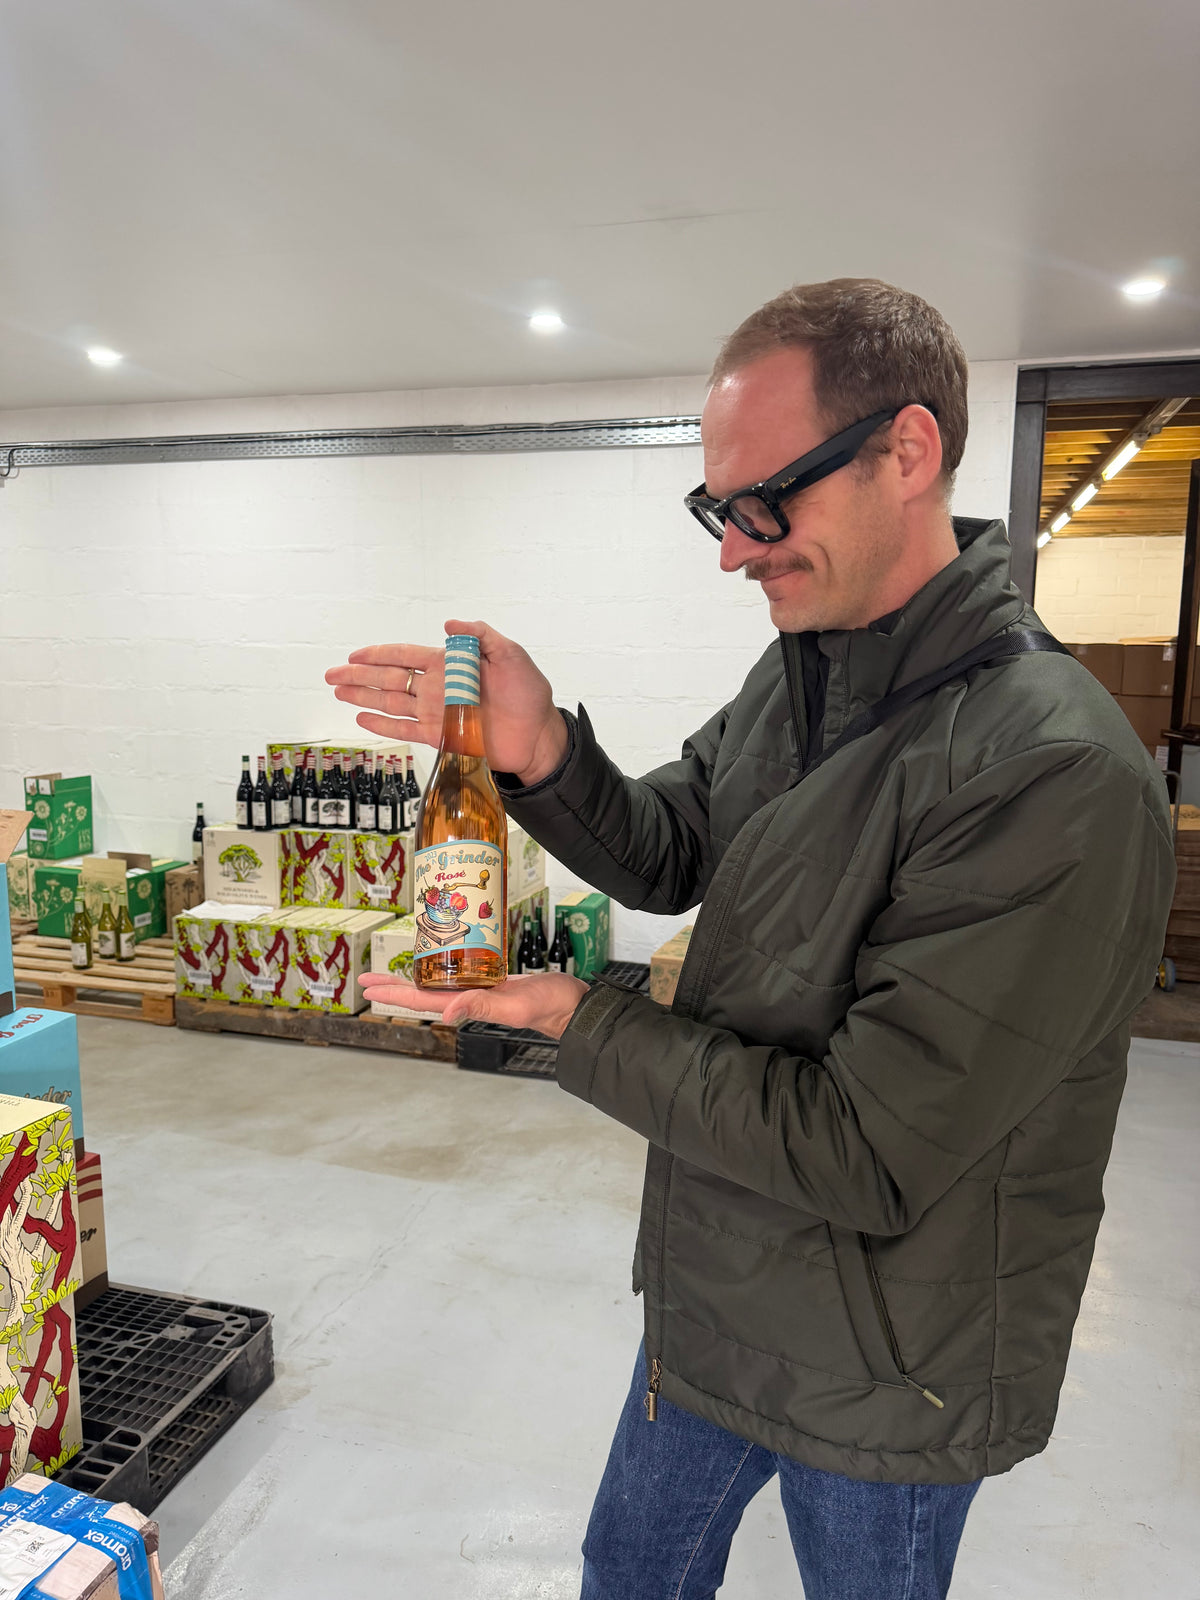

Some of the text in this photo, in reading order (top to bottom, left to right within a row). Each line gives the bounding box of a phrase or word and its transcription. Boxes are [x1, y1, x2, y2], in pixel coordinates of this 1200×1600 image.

[438, 850, 500, 870] Grinder
[435, 870, 466, 882] Rosé
[83, 1529, 132, 1571] aramex
